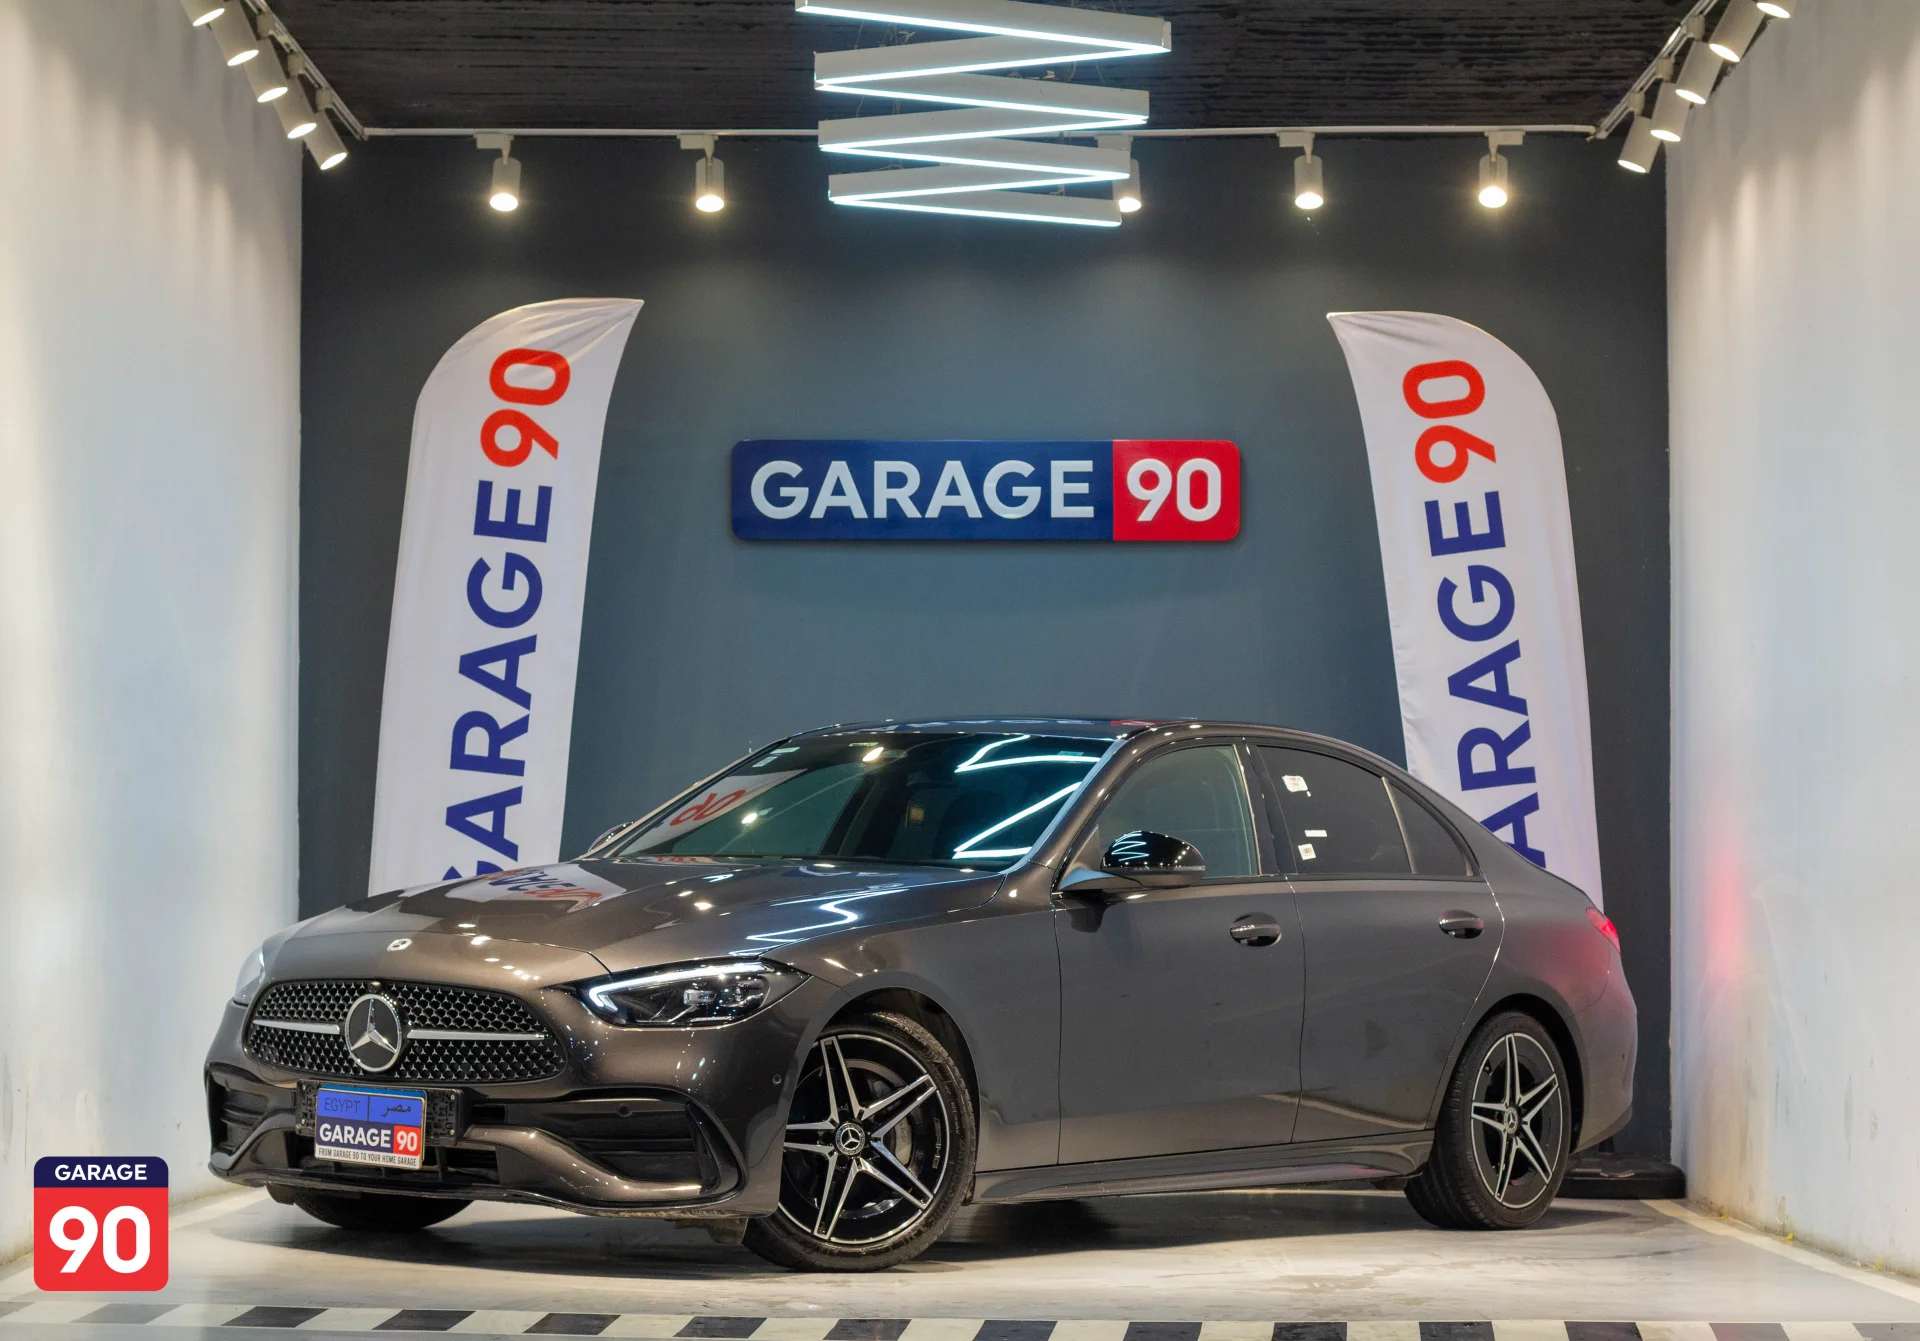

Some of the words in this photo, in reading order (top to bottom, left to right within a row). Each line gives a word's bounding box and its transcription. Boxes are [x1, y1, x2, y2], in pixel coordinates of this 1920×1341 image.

[480, 348, 571, 468] 90
[1402, 359, 1497, 484] 90
[750, 460, 1094, 519] GARAGE
[1126, 458, 1222, 522] 90
[444, 480, 552, 880] ARAGE
[1425, 490, 1547, 869] ARAGE
[319, 1123, 392, 1149] GARAGE
[396, 1131, 418, 1152] 90
[324, 1097, 360, 1114] EGYPT
[380, 1104, 411, 1117] مصر
[318, 1147, 333, 1157] FROM
[333, 1149, 352, 1159] GARAGE
[352, 1152, 359, 1160] 90
[360, 1153, 367, 1161] TO
[368, 1153, 381, 1163] YOUR
[381, 1155, 396, 1165] HOME
[397, 1156, 417, 1167] GARAGE
